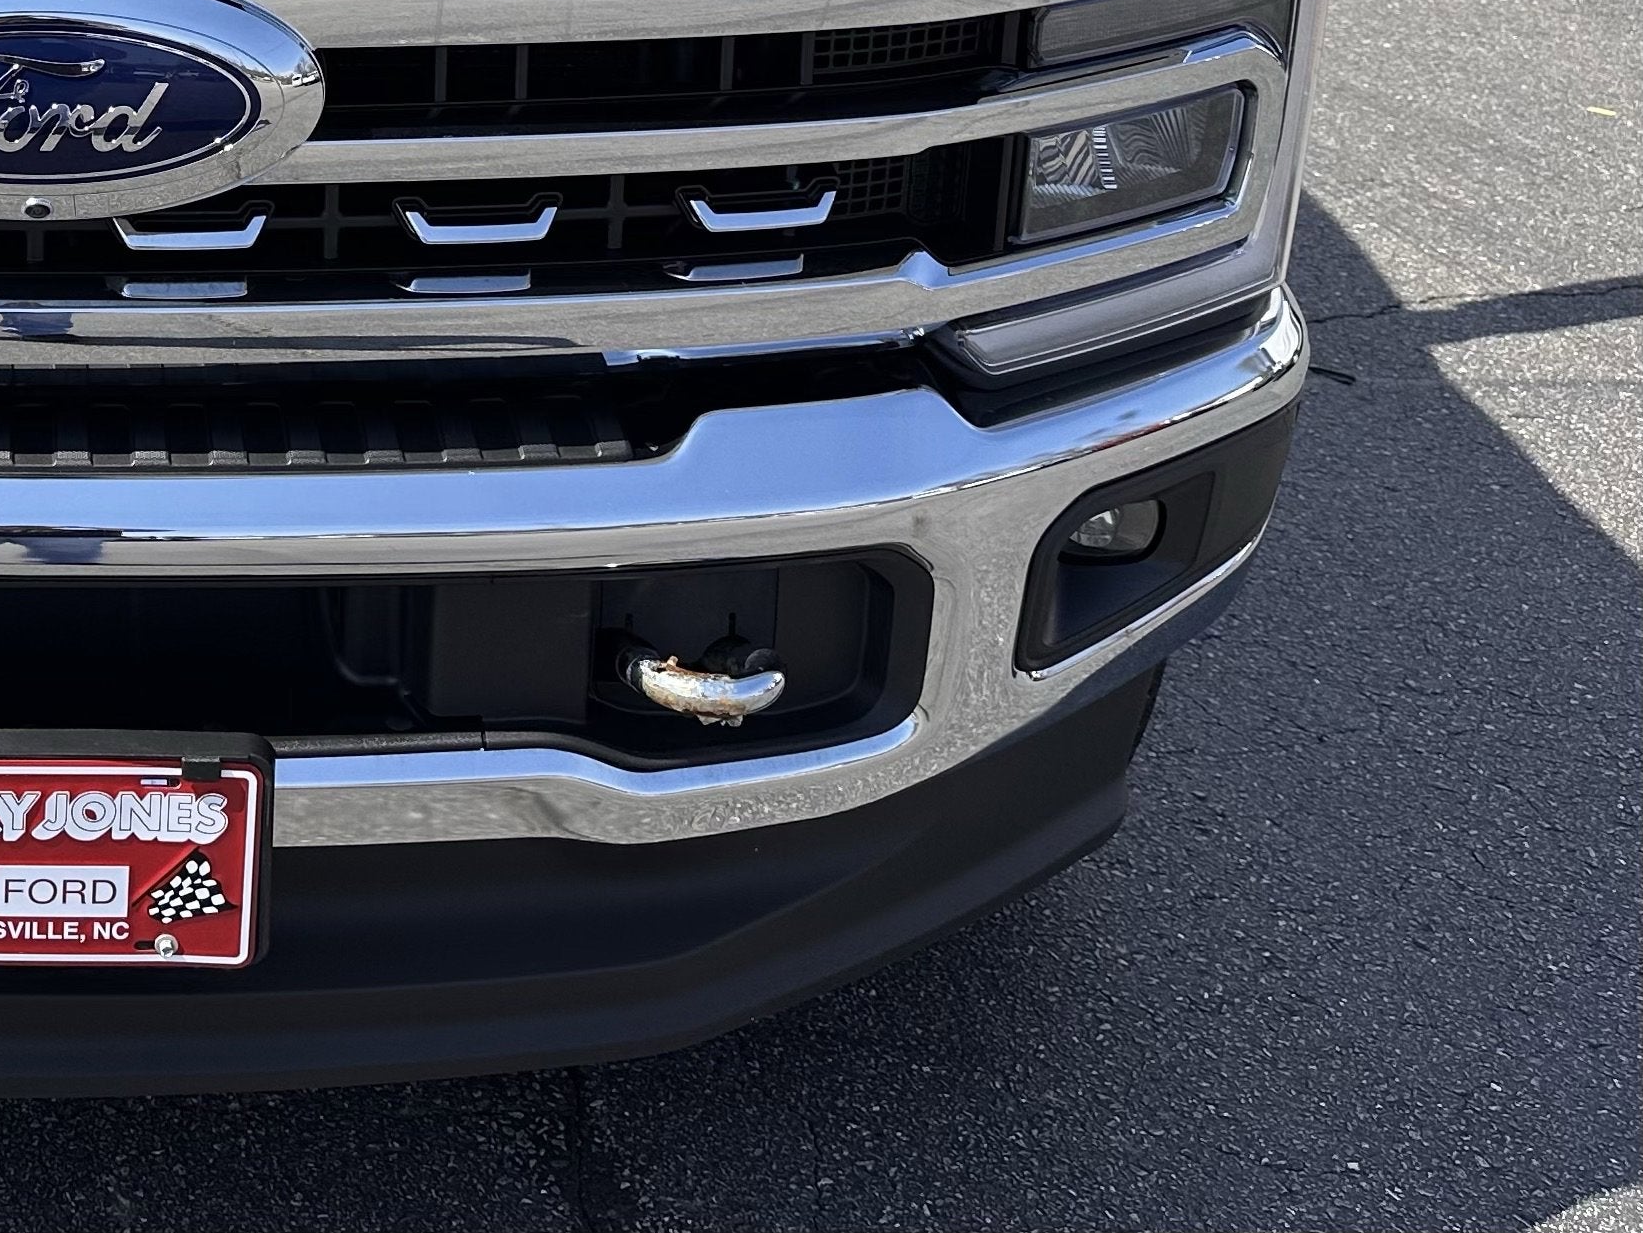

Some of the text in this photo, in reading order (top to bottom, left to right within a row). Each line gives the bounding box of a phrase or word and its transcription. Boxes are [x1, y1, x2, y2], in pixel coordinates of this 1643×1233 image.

[30, 790, 229, 845] JONES
[3, 878, 118, 905] FORD
[93, 920, 130, 940] NC
